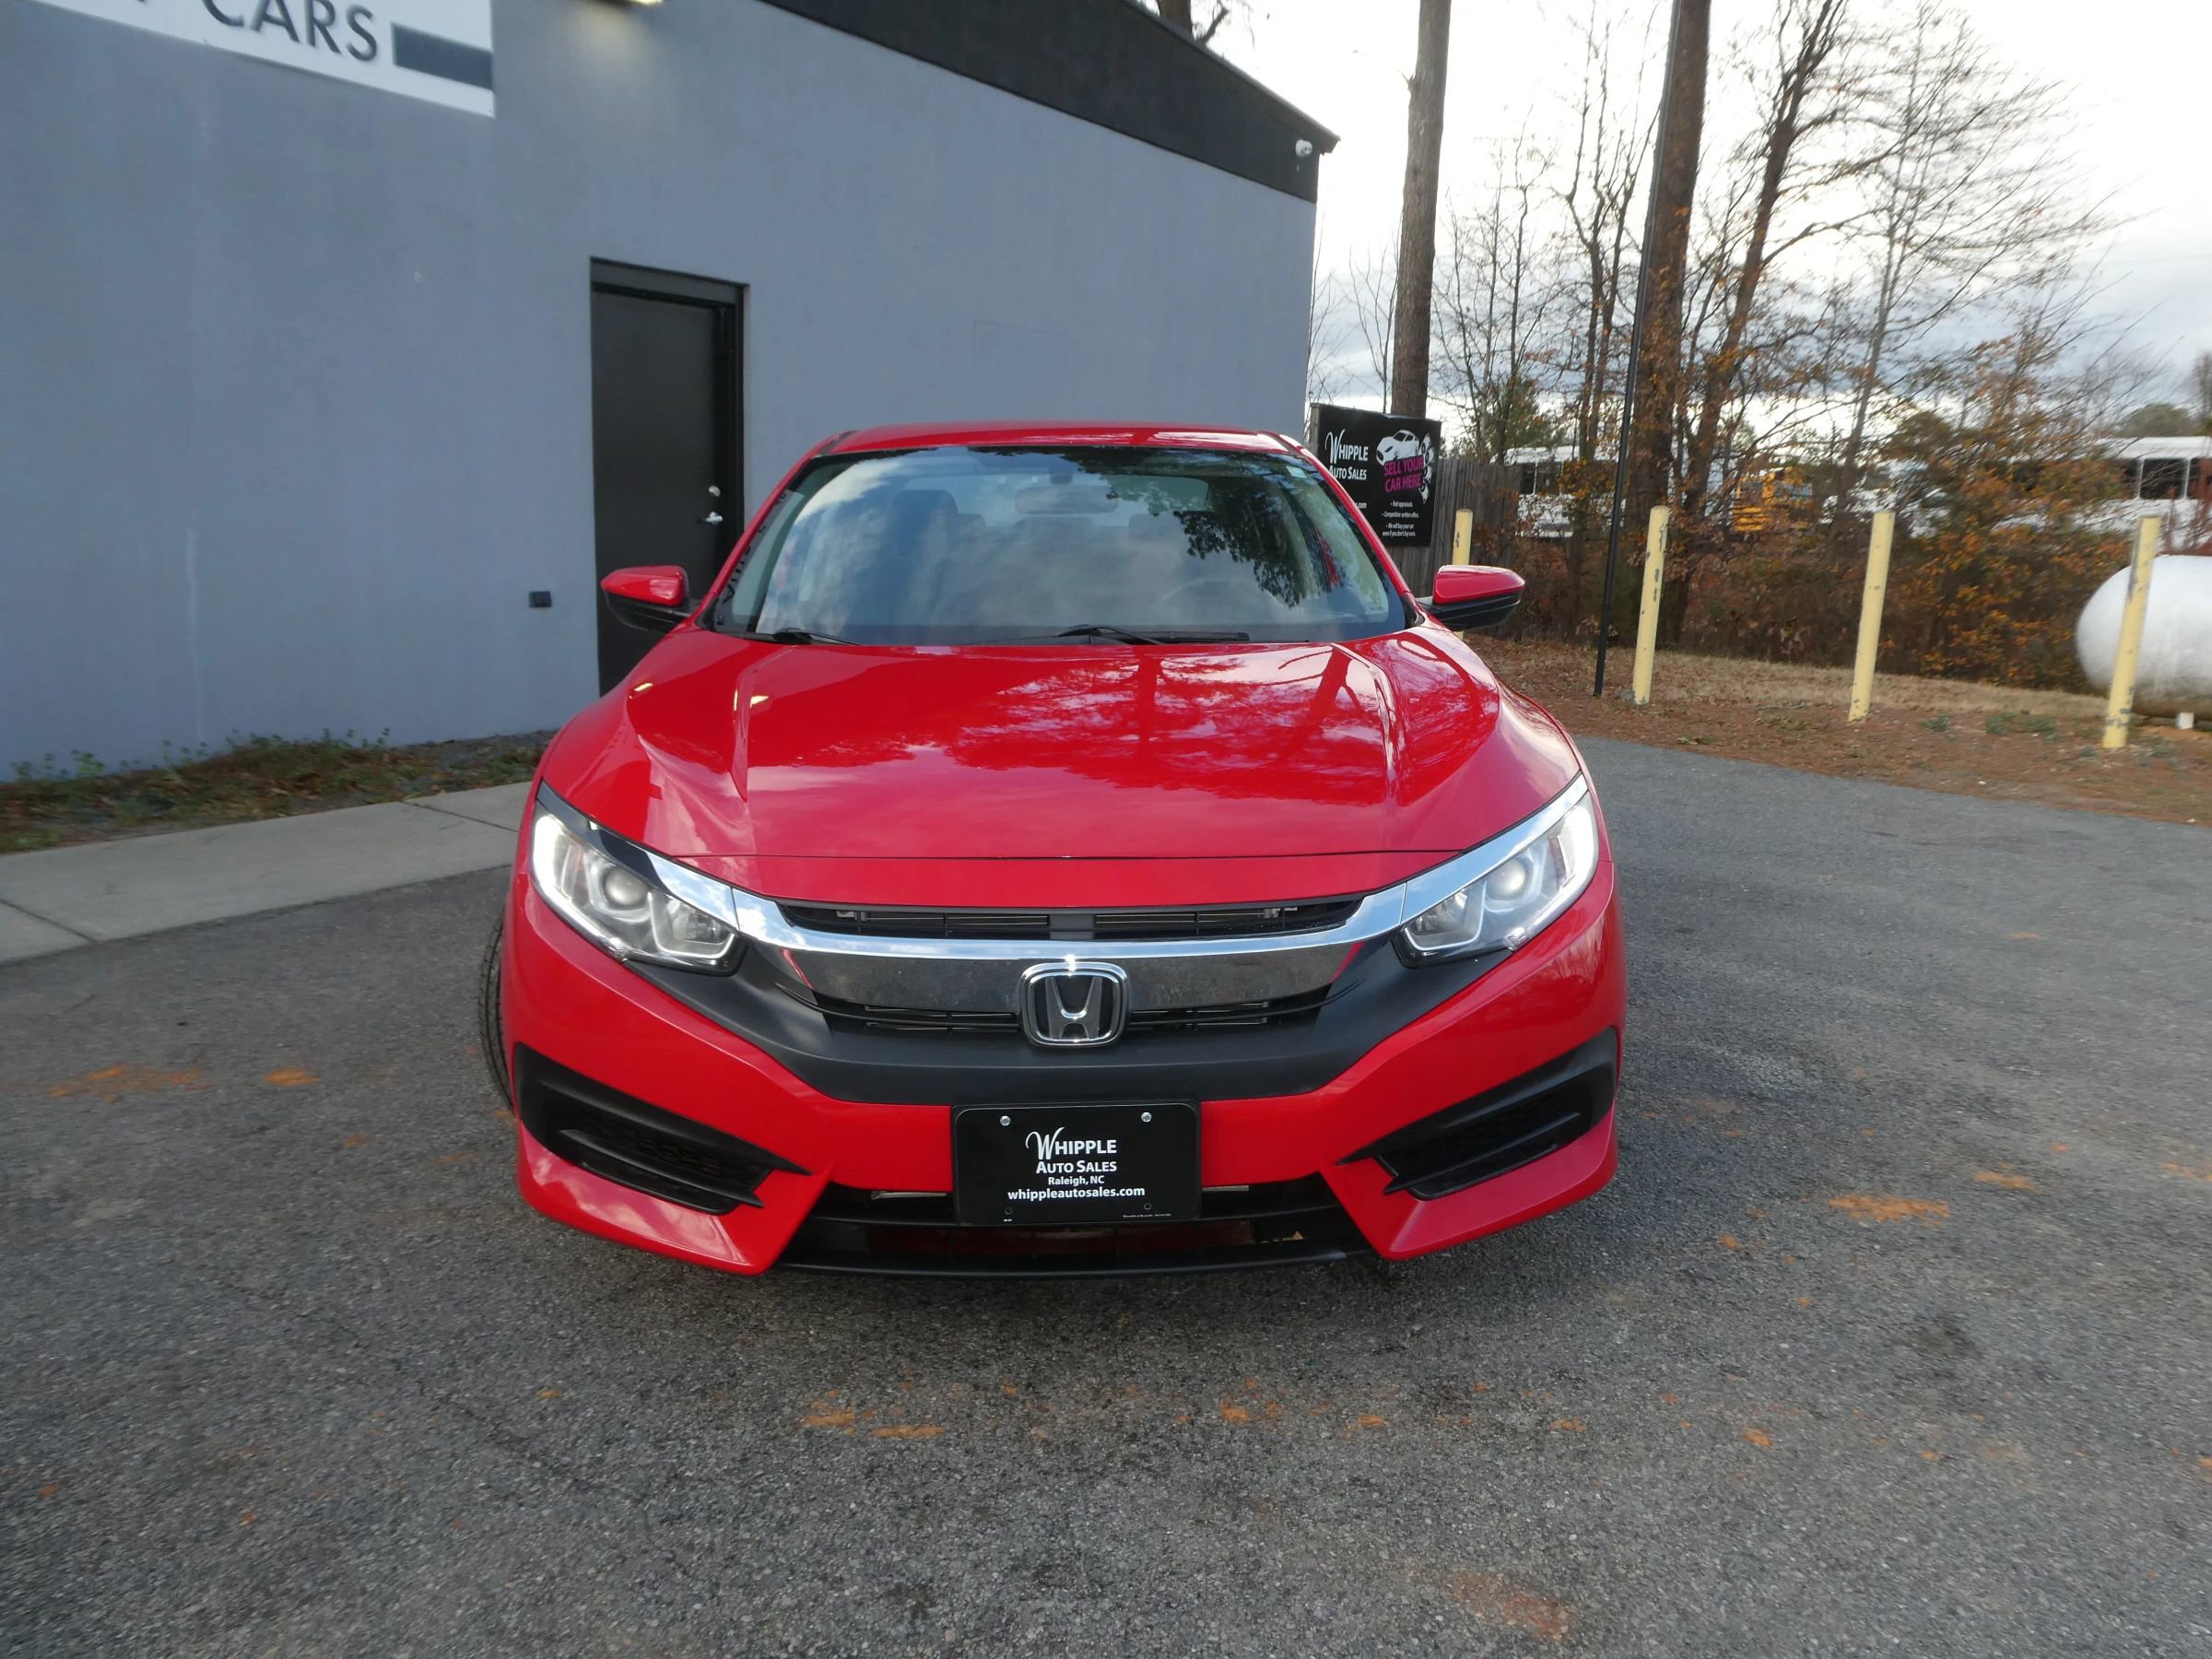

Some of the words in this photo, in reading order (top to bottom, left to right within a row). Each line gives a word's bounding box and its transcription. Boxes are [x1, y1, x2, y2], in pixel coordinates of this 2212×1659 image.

[1324, 429, 1369, 464] WHIPPLE
[1328, 465, 1347, 479] AUTO
[1347, 466, 1367, 480] SALES
[1384, 461, 1401, 476] SELL
[1404, 456, 1424, 472] YOUR
[1385, 477, 1401, 493] CAR
[1402, 473, 1421, 488] HERE
[1025, 1126, 1117, 1160] WHIPPLE
[1035, 1161, 1074, 1174] AUTO
[1077, 1159, 1117, 1172] SALES
[1048, 1176, 1089, 1187] Raleigh,
[1089, 1175, 1105, 1184] NC
[1007, 1186, 1146, 1201] whippleautosales.com
